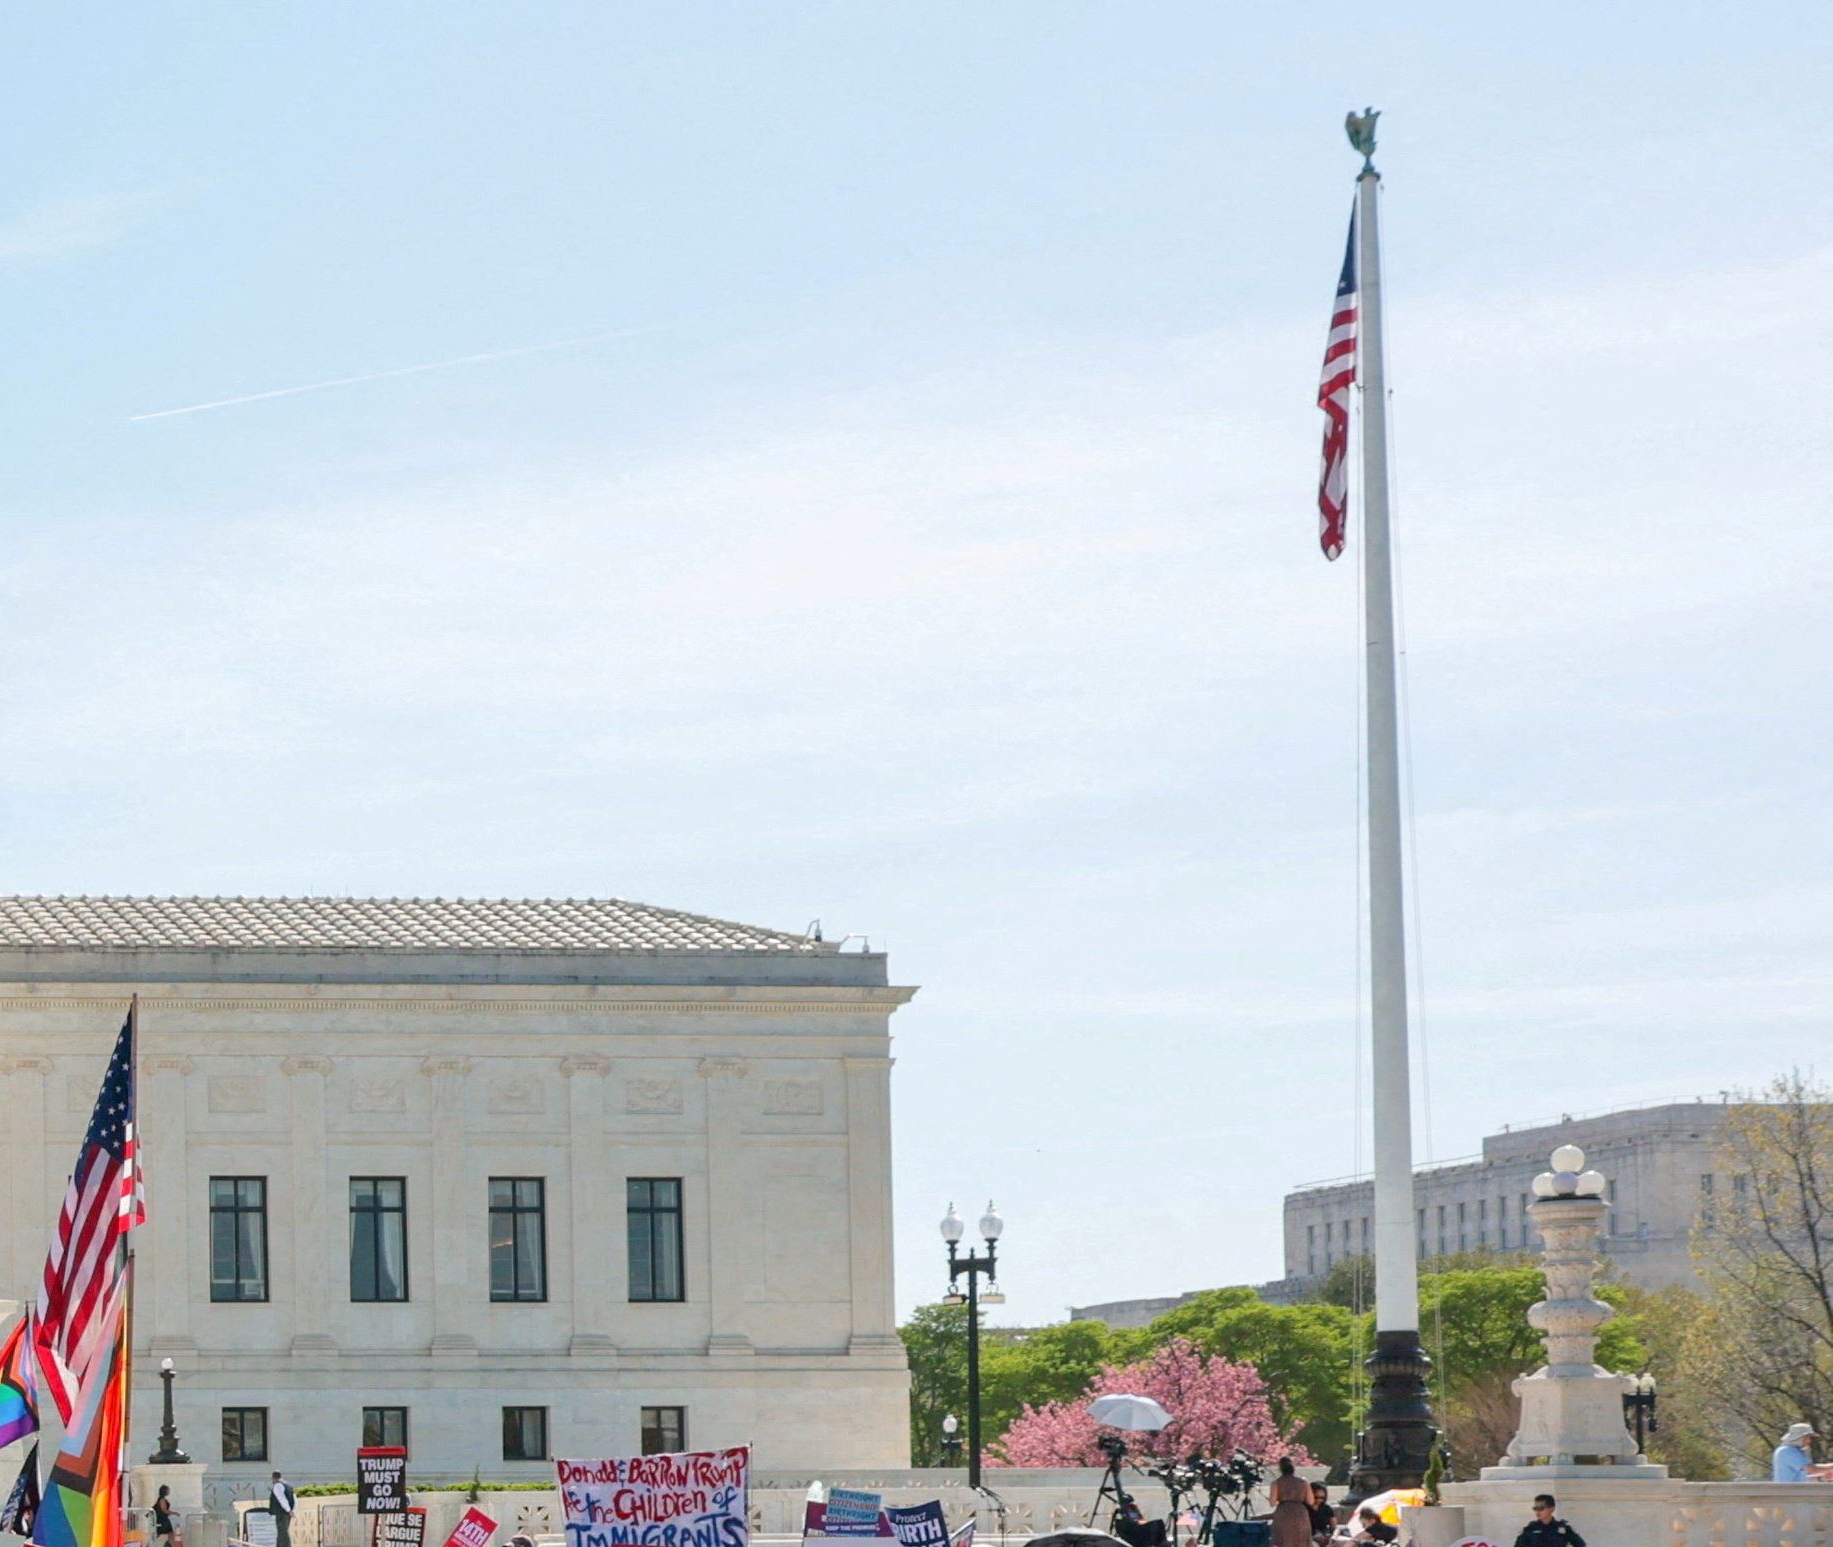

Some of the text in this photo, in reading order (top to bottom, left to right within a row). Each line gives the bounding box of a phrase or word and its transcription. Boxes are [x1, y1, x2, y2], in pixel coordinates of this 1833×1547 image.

[359, 1458, 404, 1471] TRUMP
[364, 1471, 400, 1483] MUST
[373, 1484, 393, 1496] GO
[366, 1497, 401, 1509] NOW!
[407, 1513, 422, 1527] SE
[895, 1511, 927, 1523] Protect
[459, 1518, 489, 1544] 14TH
